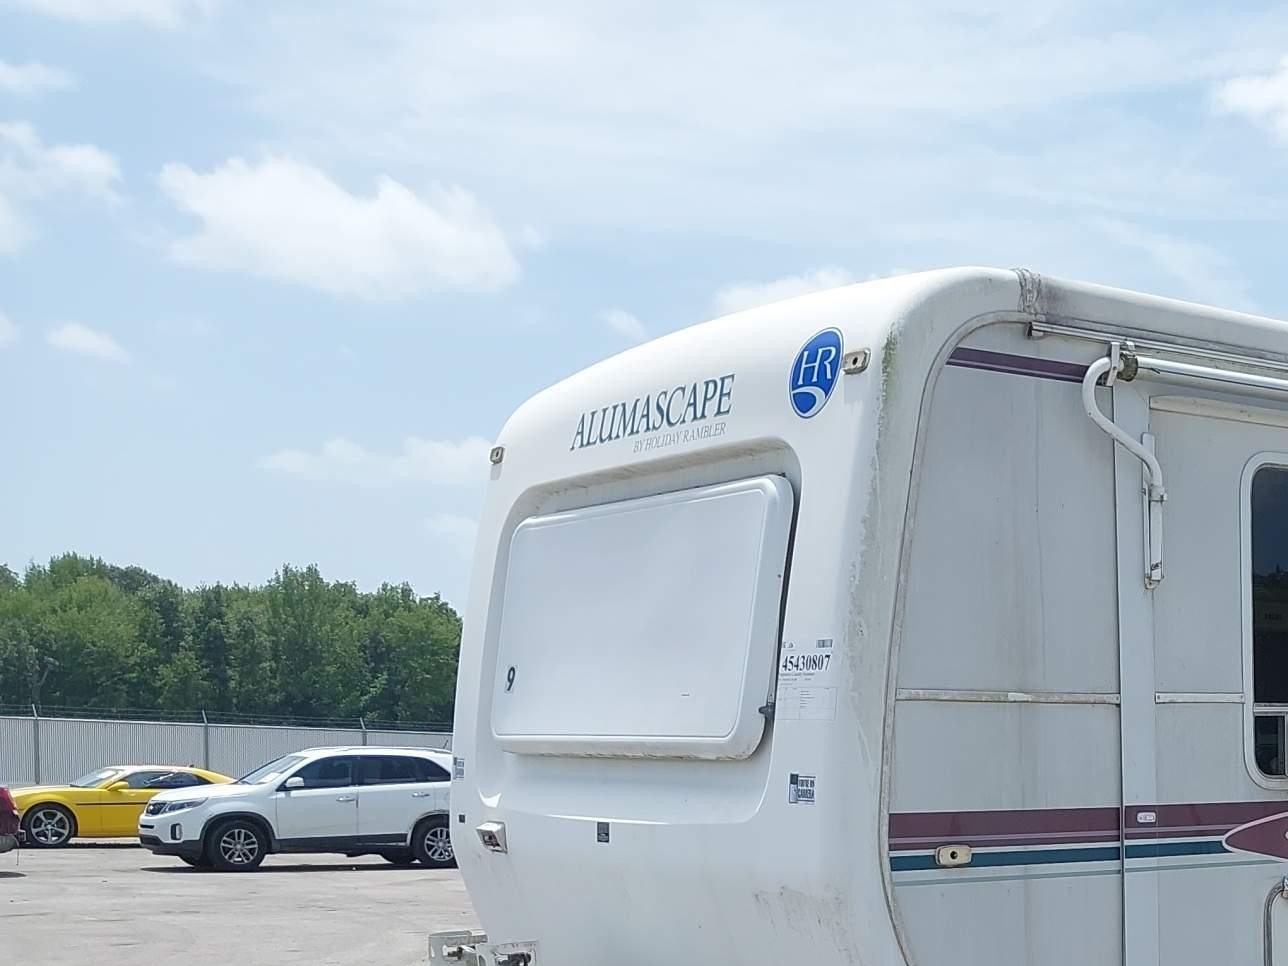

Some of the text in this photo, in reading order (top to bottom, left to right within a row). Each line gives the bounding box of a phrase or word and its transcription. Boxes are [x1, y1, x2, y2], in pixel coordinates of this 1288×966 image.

[797, 346, 837, 386] HR
[569, 373, 736, 451] ALUMASCAPE
[633, 422, 727, 453] BY HOLIDAY RAMBLER
[781, 654, 832, 672] 45430807
[506, 666, 516, 692] 9
